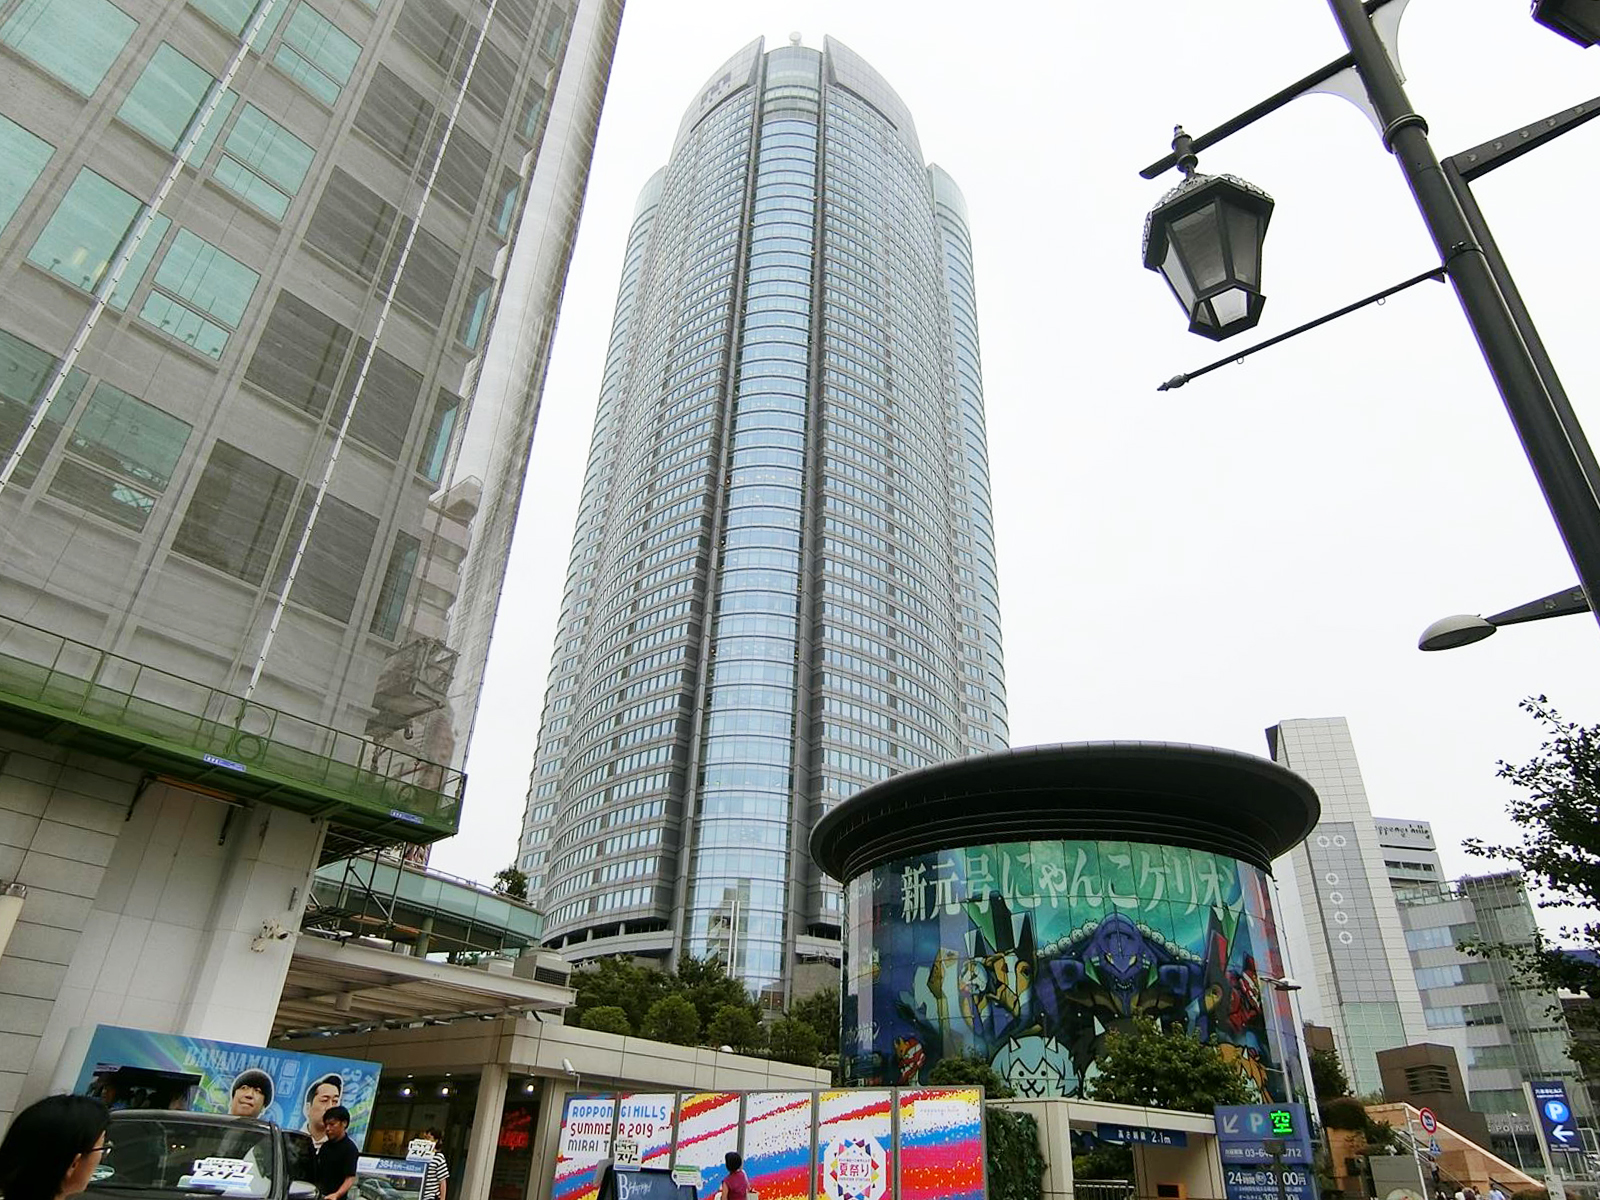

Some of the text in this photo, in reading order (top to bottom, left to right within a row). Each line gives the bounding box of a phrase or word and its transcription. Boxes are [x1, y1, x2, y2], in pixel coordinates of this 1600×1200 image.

[183, 1046, 281, 1077] BANANAMAN
[572, 1105, 666, 1121] ROPPONGI HILLS
[1548, 1103, 1564, 1120] P
[1250, 1113, 1263, 1133] P
[1270, 1109, 1293, 1134] 空
[570, 1122, 653, 1138] SUMMER 2019
[1151, 1131, 1172, 1145] 2.1m
[567, 1139, 599, 1152] MIRAI
[839, 1162, 870, 1178] 夏祭り
